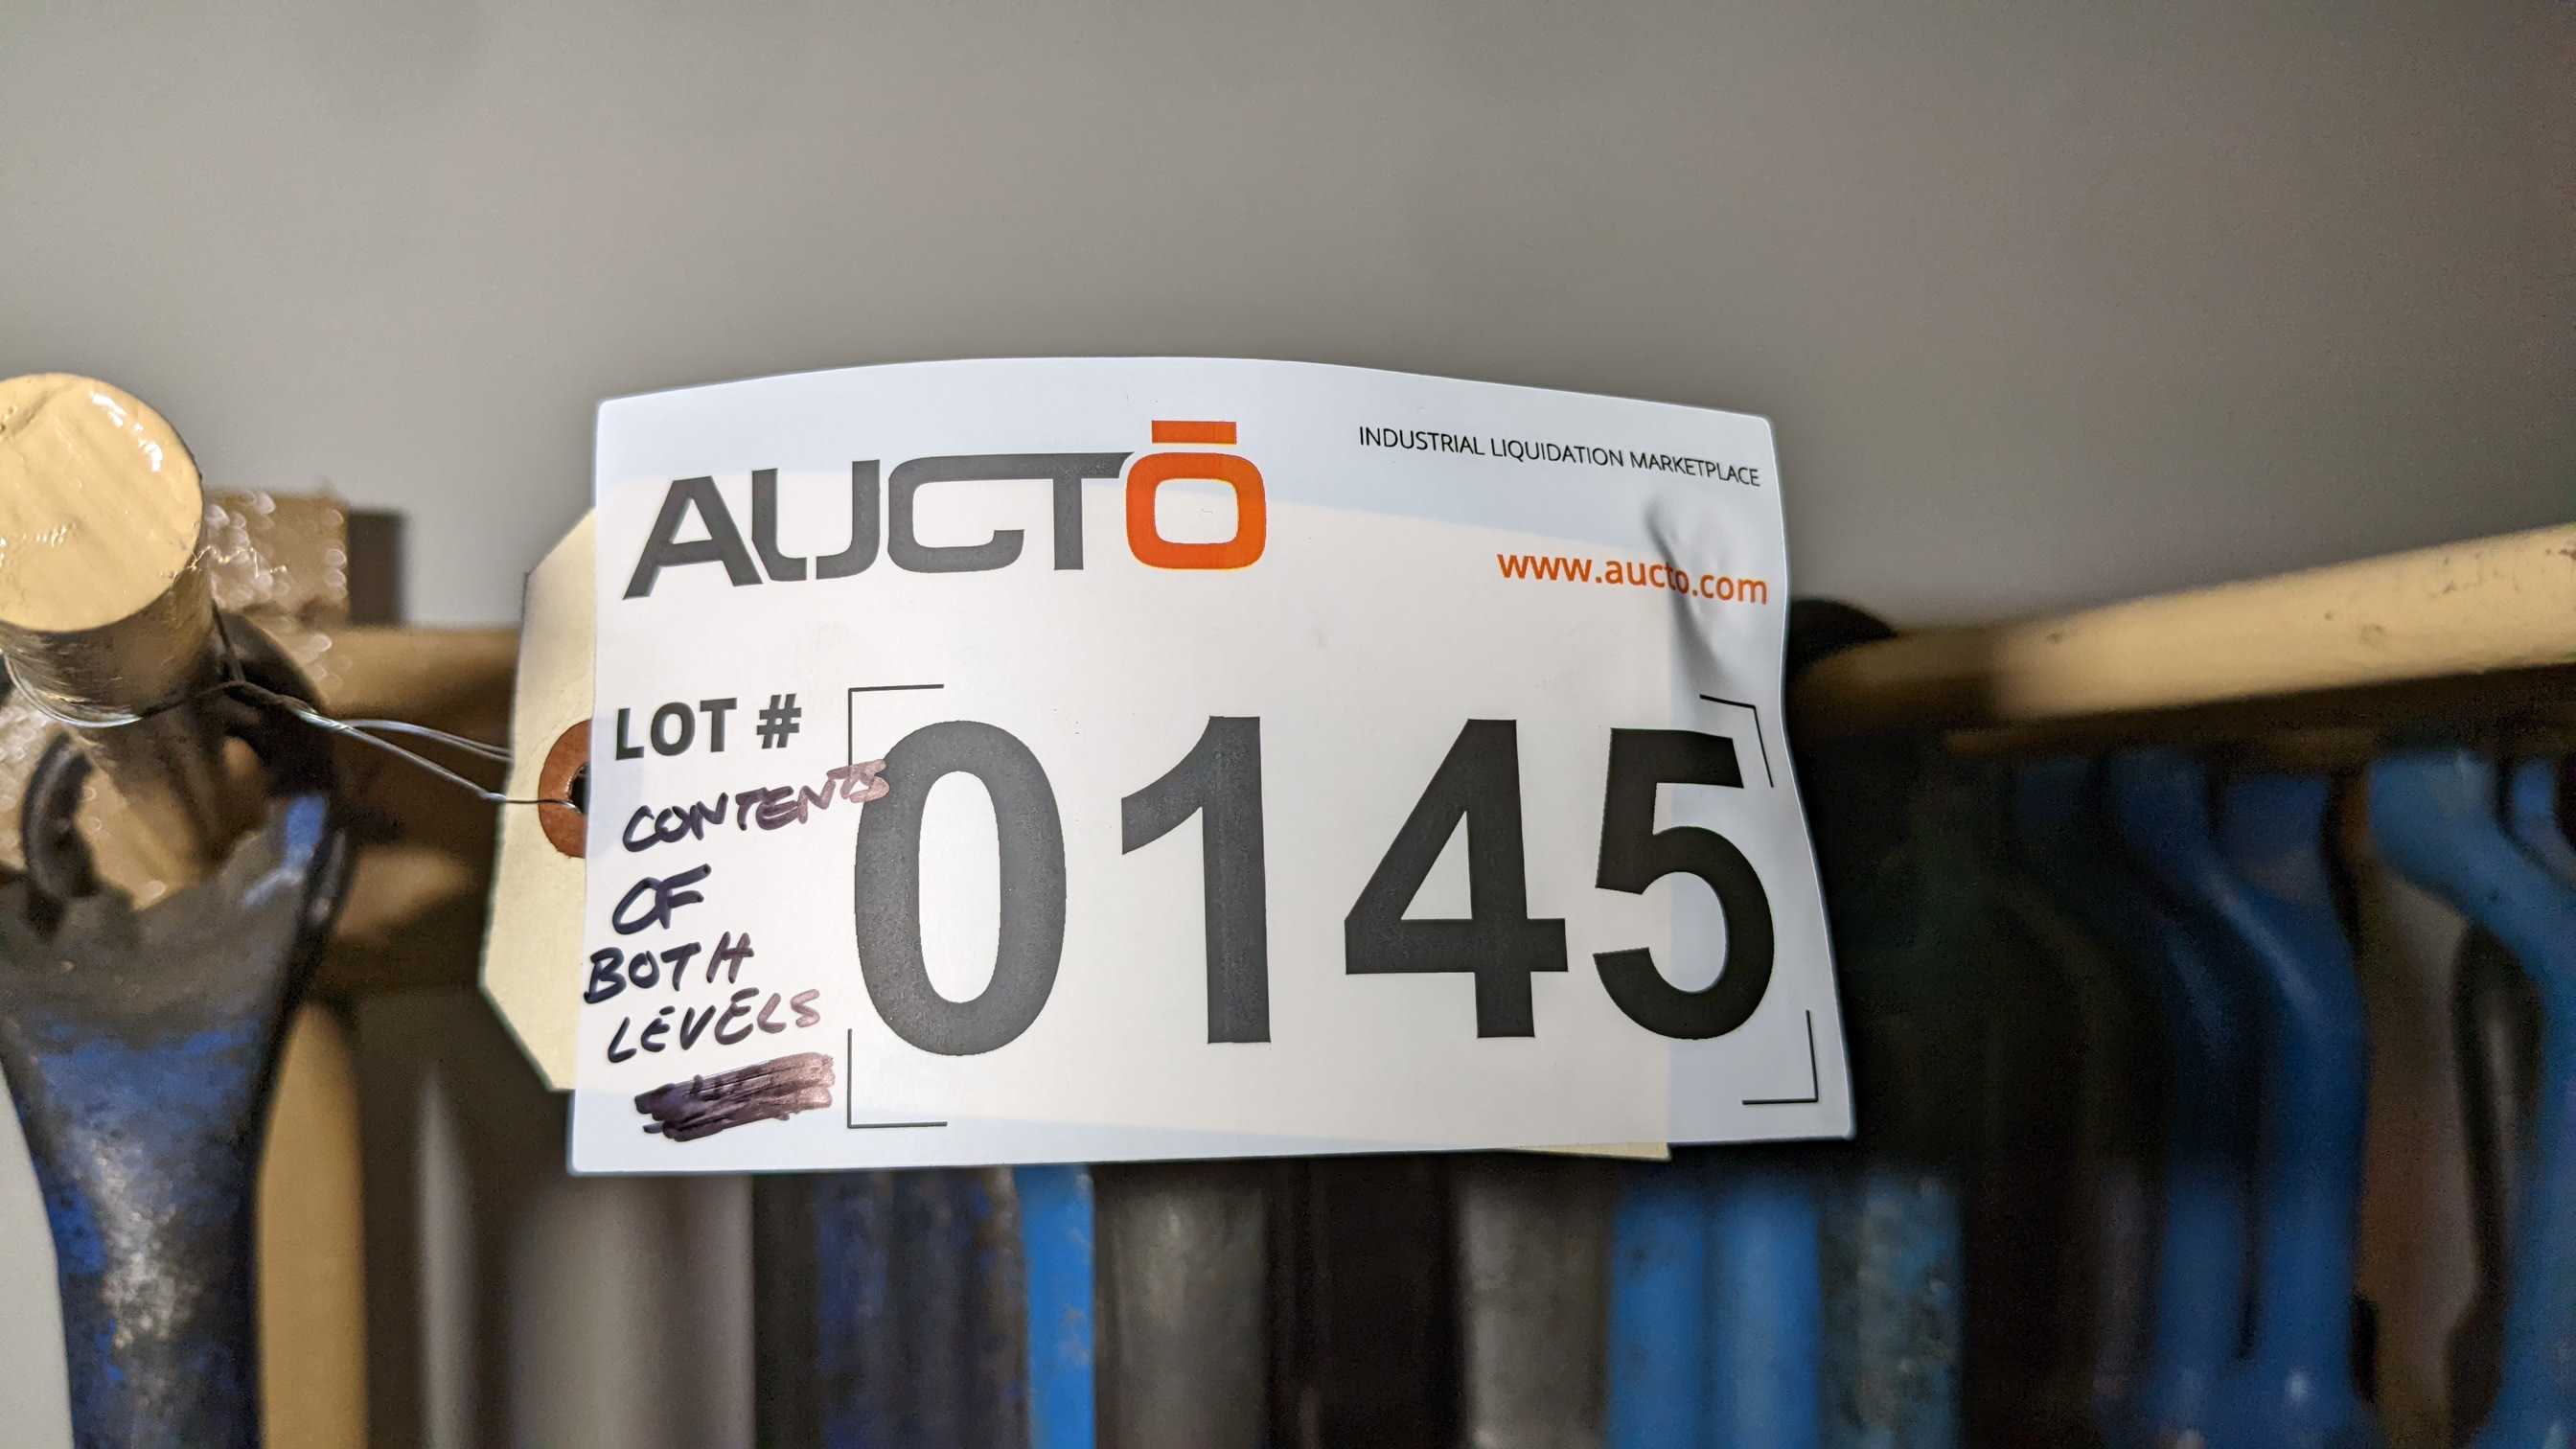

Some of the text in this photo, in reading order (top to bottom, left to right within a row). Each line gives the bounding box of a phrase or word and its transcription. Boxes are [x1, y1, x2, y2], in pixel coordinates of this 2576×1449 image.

[1359, 426, 1760, 487] INDUSTRIAL LIQUIDATION MARKETPLACE
[1497, 553, 1767, 605] www.aucto.com
[615, 694, 802, 760] LOT #
[623, 759, 889, 852] CONTENTS
[612, 863, 711, 934] OF
[854, 715, 1775, 1056] 0145
[584, 932, 753, 1003] BOTH
[608, 987, 820, 1063] LEVELS
